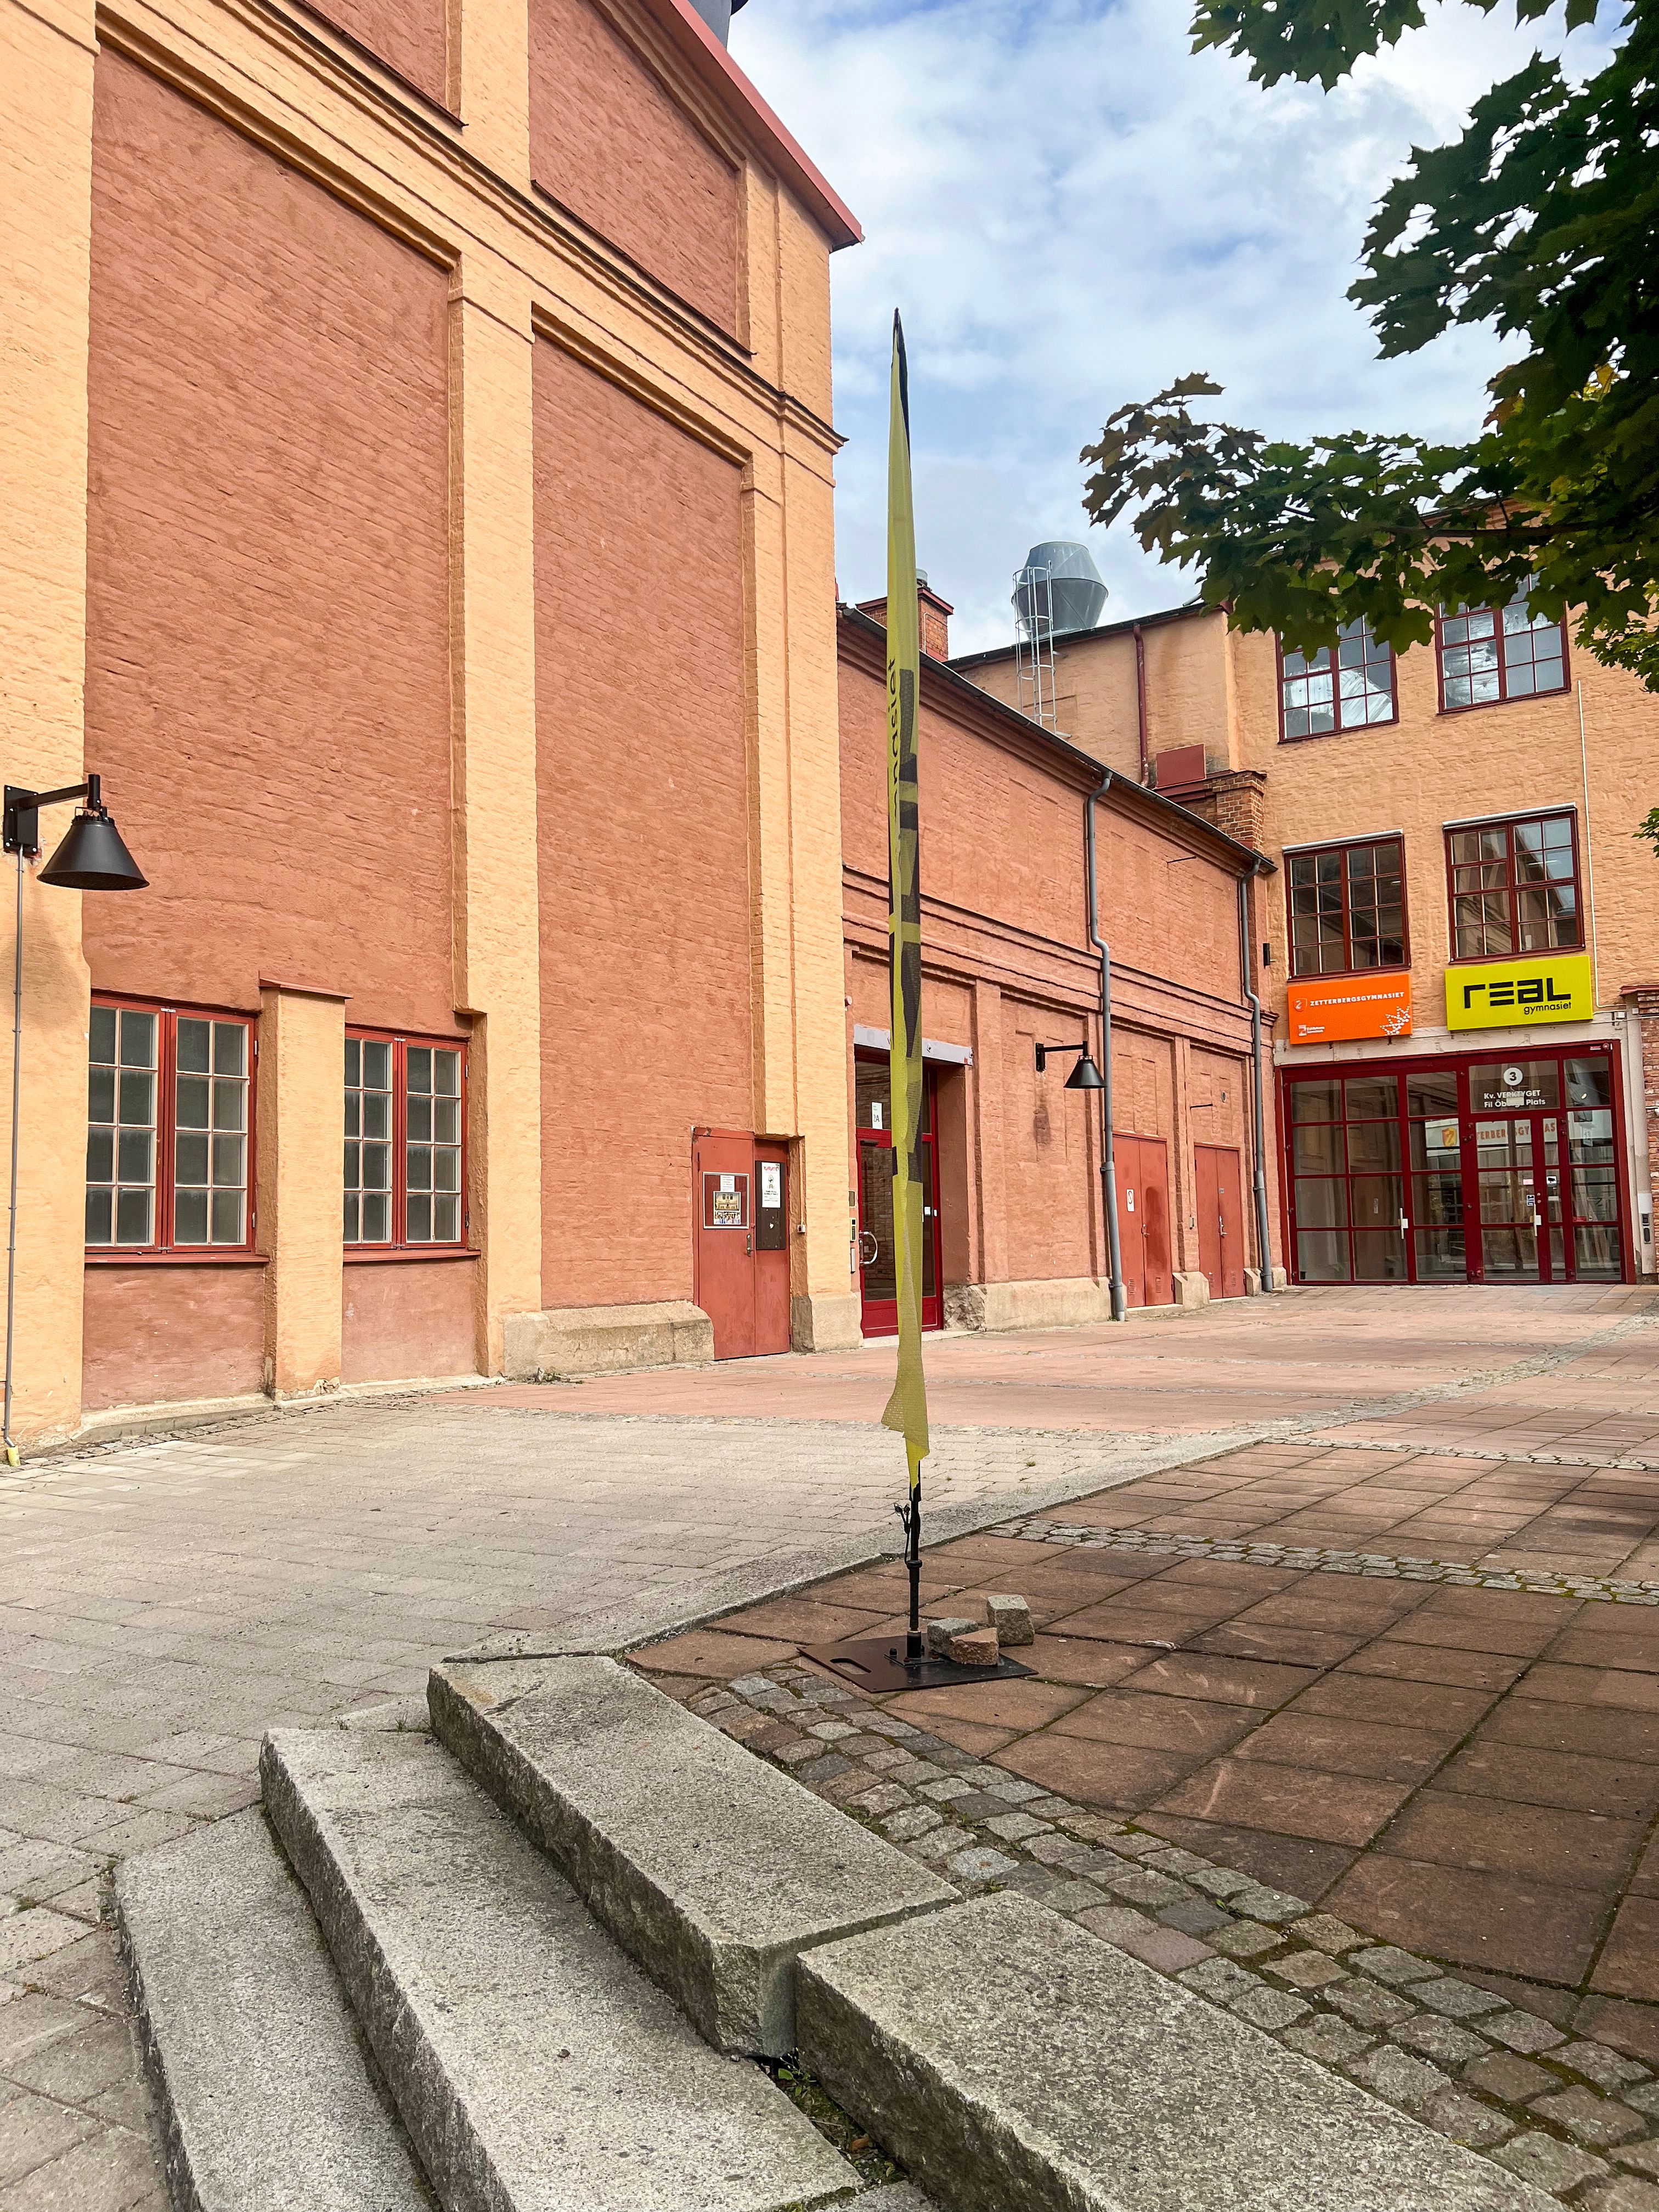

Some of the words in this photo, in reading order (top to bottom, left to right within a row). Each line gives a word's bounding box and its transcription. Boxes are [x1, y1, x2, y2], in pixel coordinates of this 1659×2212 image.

[1310, 992, 1404, 1006] ZETTERBERGSGYMNASIET
[1523, 1001, 1571, 1015] gymnasiet
[1509, 1071, 1517, 1081] 3
[1497, 1090, 1541, 1098] VERKTYGET
